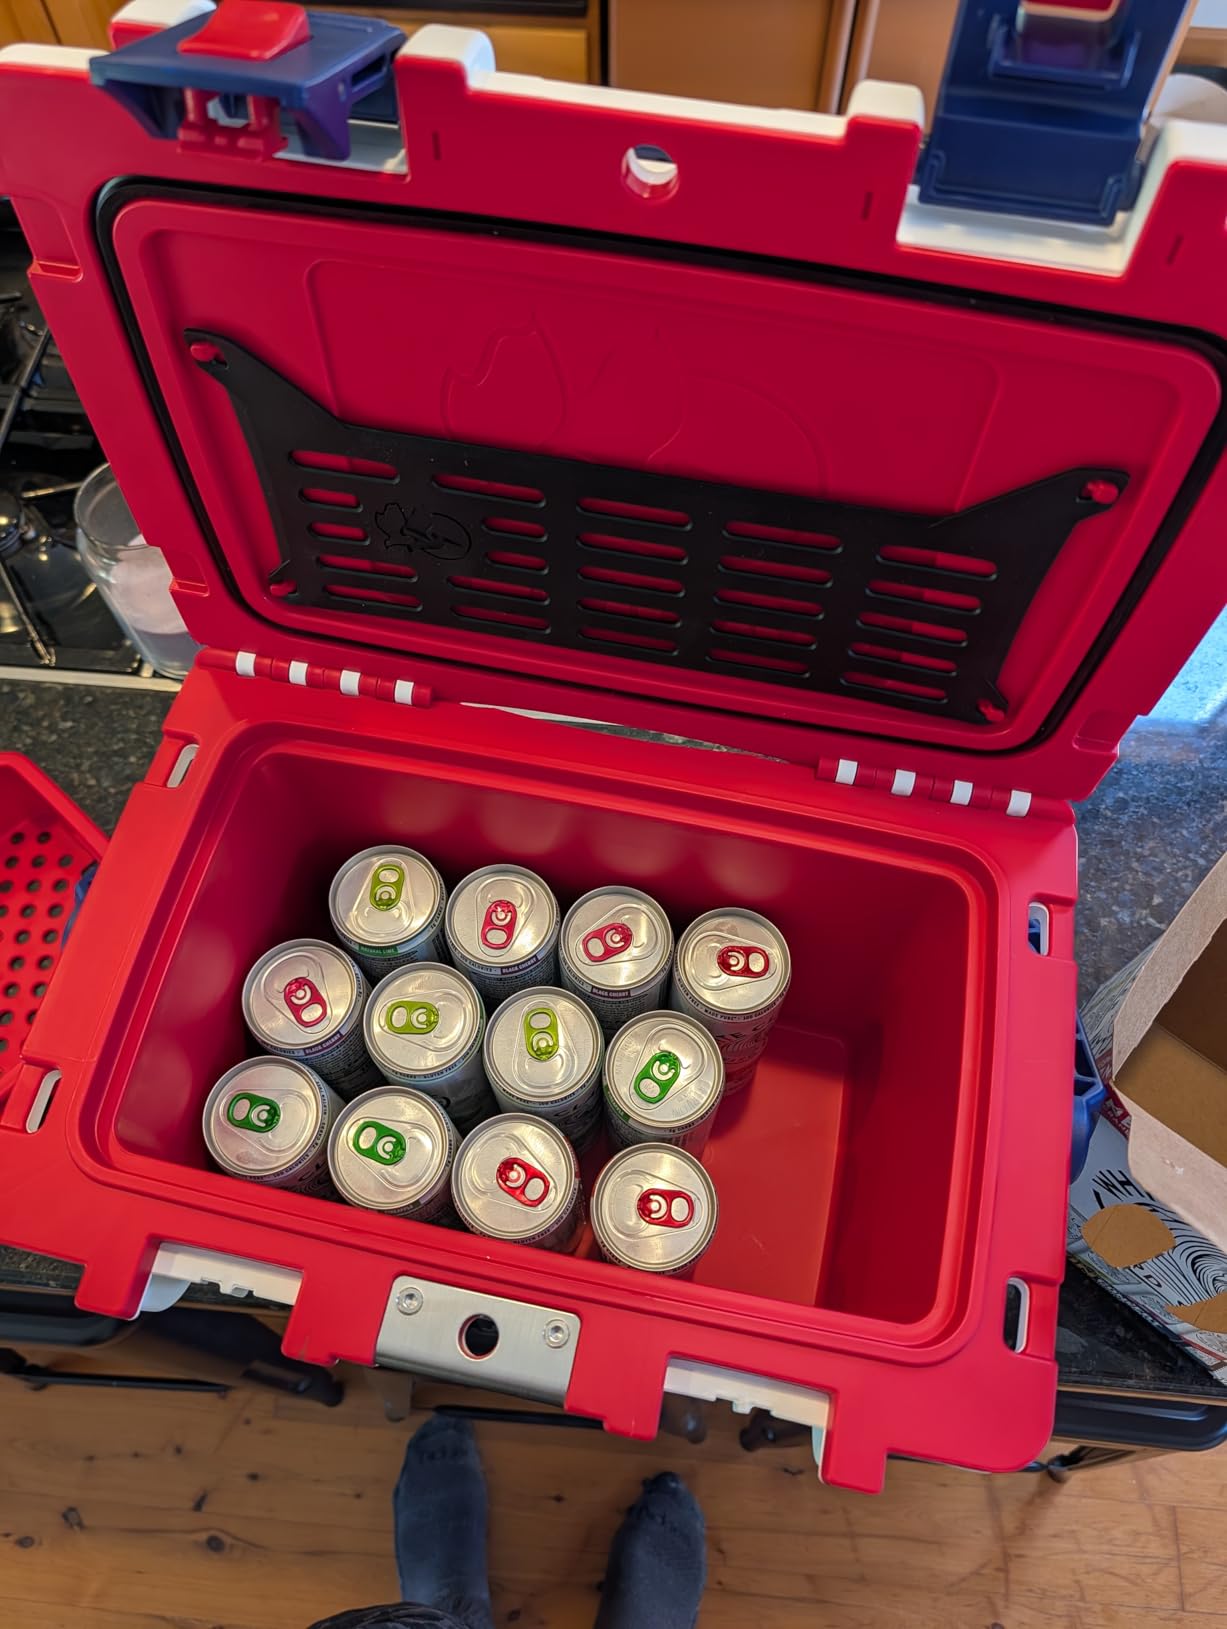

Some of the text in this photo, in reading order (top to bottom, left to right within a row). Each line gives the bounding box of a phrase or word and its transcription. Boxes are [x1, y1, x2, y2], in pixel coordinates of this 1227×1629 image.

[468, 960, 493, 973] CALORIES
[502, 957, 538, 975] BLACK CHERRY
[592, 988, 629, 998] BLACK CHERRY
[688, 995, 700, 1008] FREE
[704, 1008, 719, 1019] MADE
[305, 1034, 341, 1055] BLACK CHERRY
[423, 1070, 444, 1079] GLUTEN
[444, 1063, 458, 1073] FREE
[550, 1092, 576, 1105] CALORIES
[285, 1152, 310, 1174] CALORIES
